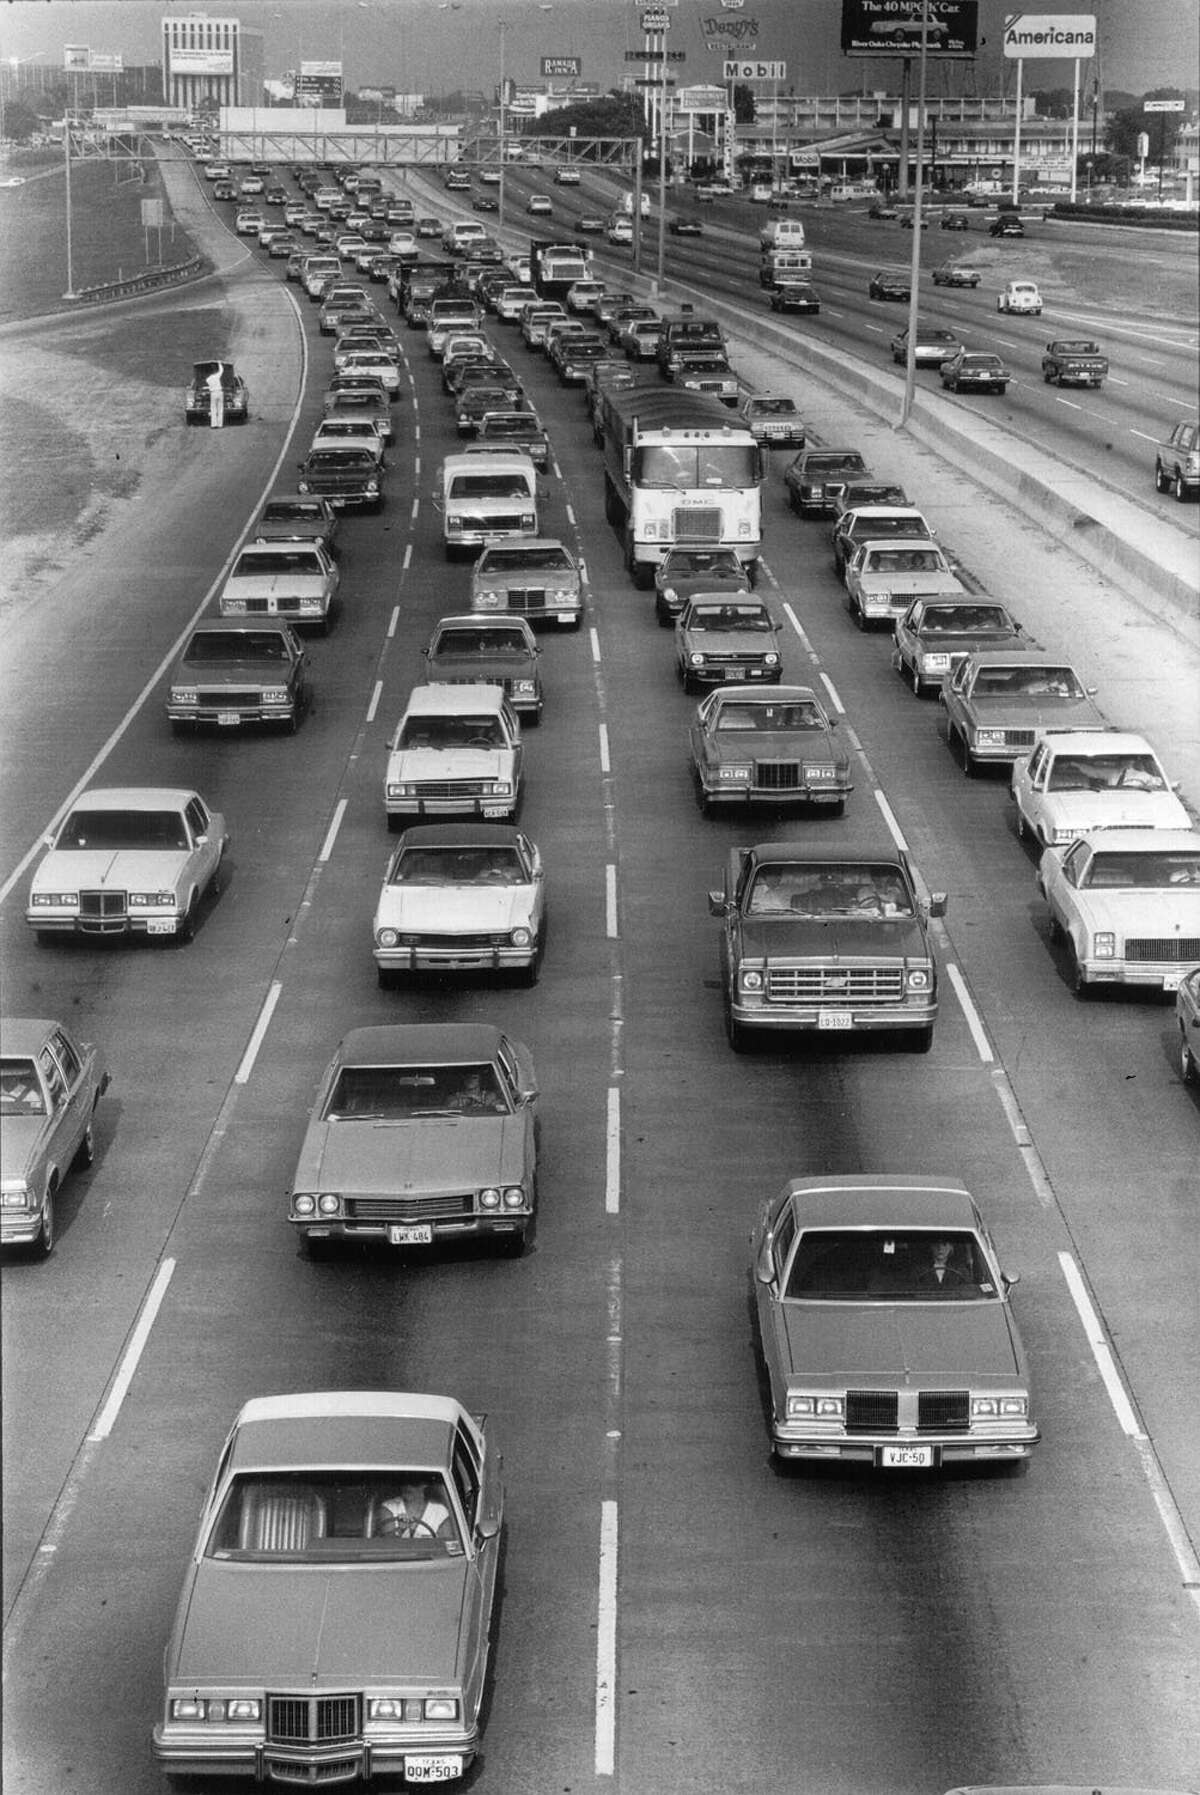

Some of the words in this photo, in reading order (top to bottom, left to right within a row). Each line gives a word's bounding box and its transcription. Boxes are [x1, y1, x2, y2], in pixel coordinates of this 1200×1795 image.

[862, 1, 881, 11] The
[884, 1, 898, 12] 40
[940, 2, 960, 12] Car
[703, 18, 759, 40] Denny's
[1006, 27, 1094, 45] Americana
[726, 63, 785, 78] Mobil
